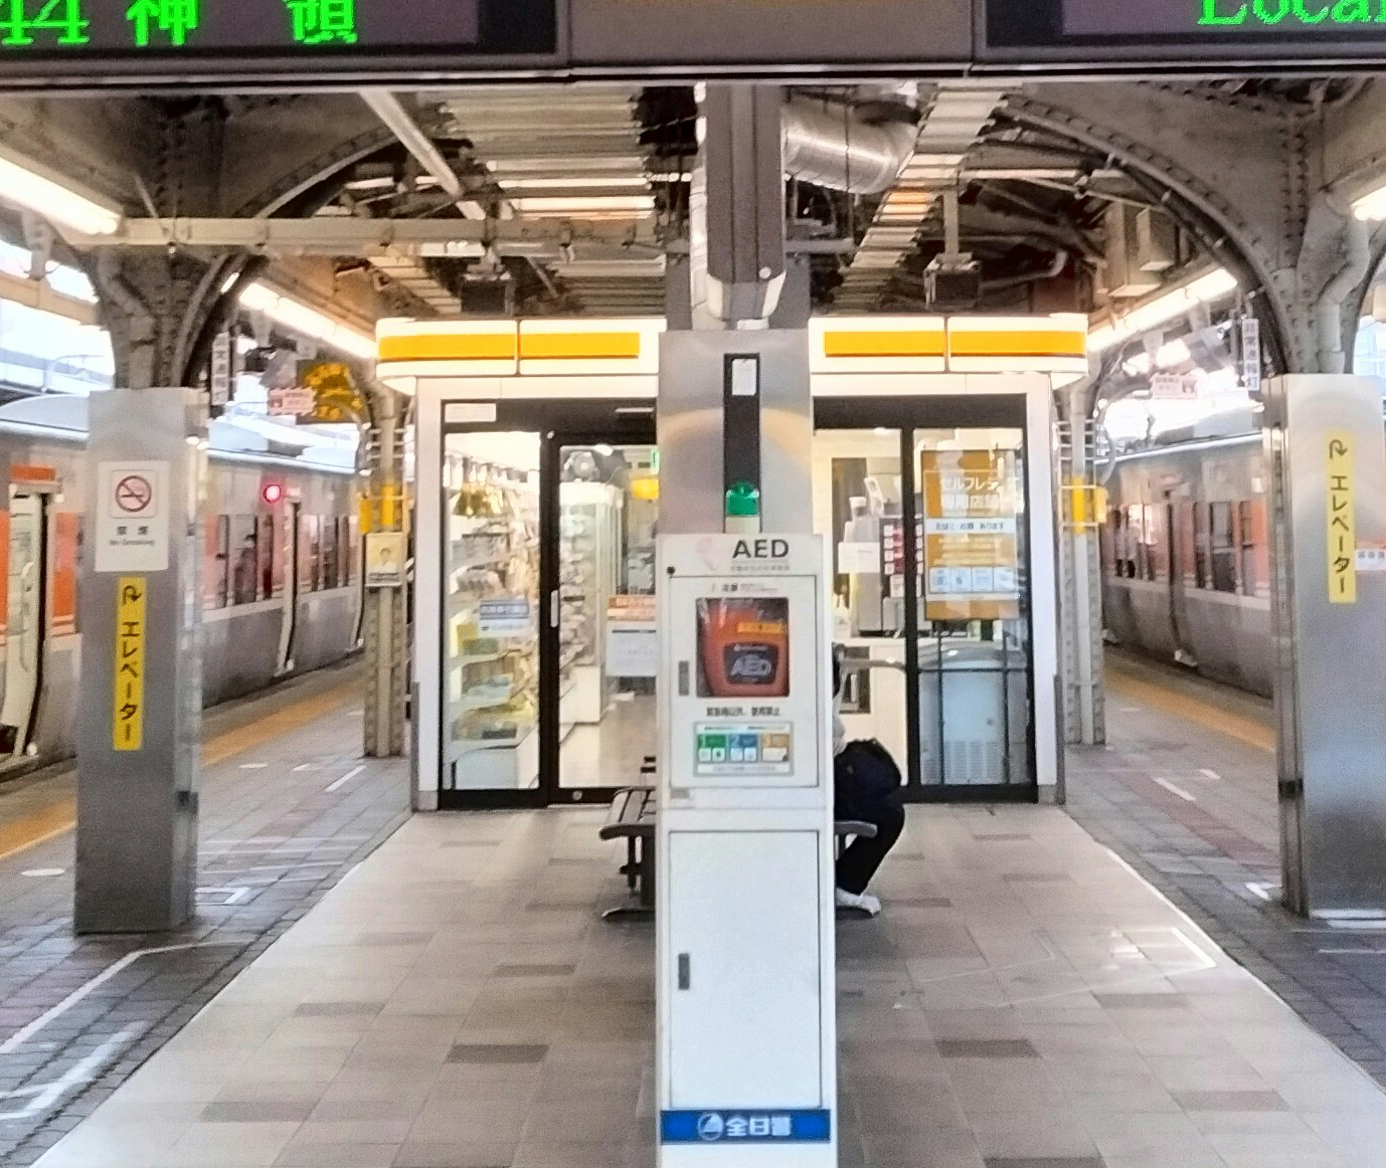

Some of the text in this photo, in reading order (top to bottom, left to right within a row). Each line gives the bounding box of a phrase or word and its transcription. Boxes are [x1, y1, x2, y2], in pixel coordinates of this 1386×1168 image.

[731, 538, 790, 559] AED
[1330, 475, 1350, 594] エレベーター
[120, 621, 141, 742] エレベーター
